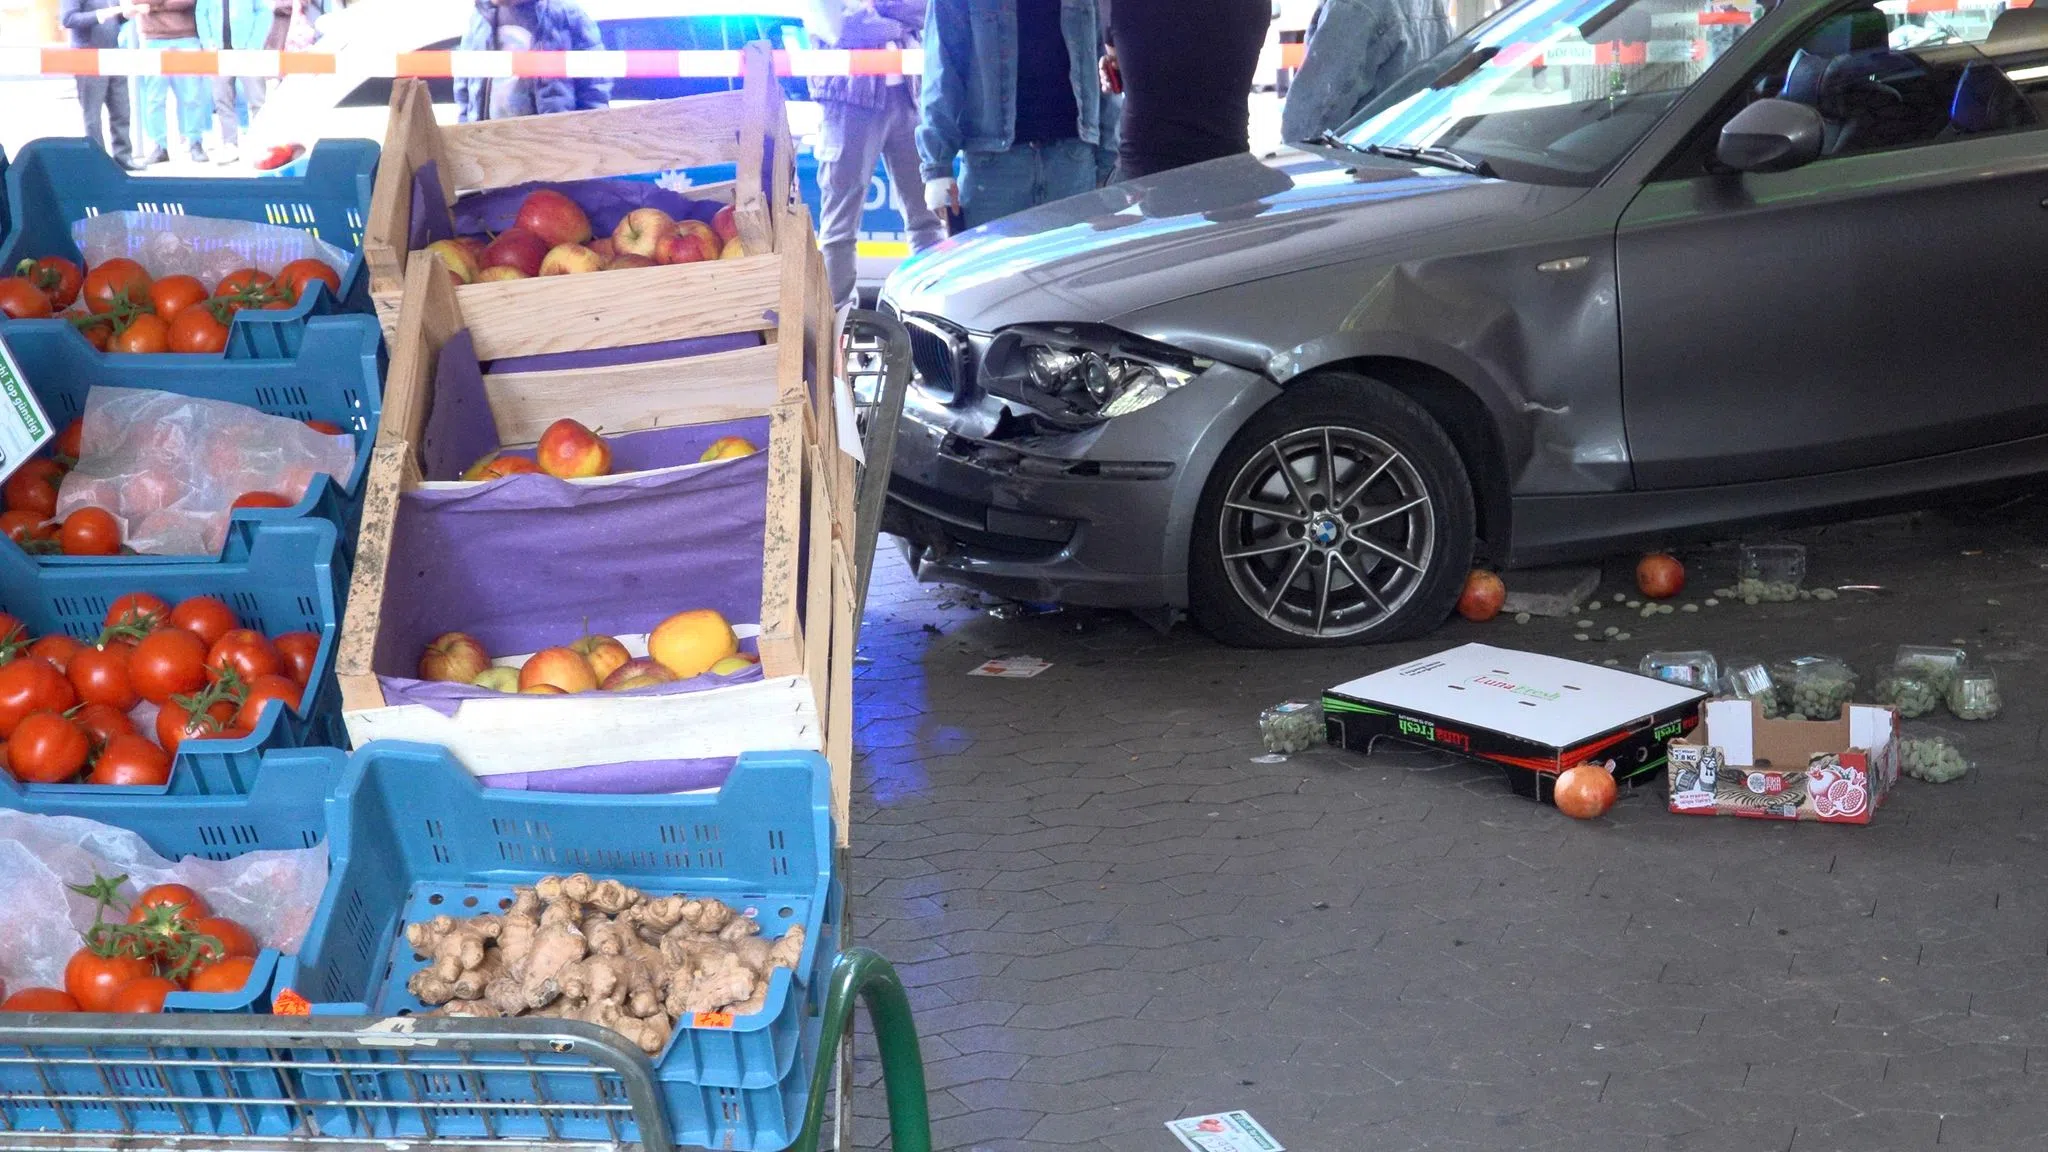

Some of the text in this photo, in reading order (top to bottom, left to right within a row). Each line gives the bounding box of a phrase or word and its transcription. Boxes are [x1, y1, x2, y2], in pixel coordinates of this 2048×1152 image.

[5, 378, 18, 397] Top
[15, 397, 42, 436] günstig!
[1474, 676, 1516, 690] Luna
[1399, 720, 1435, 741] Fresh
[1436, 727, 1470, 752] Luna
[1654, 722, 1682, 742] Fresh
